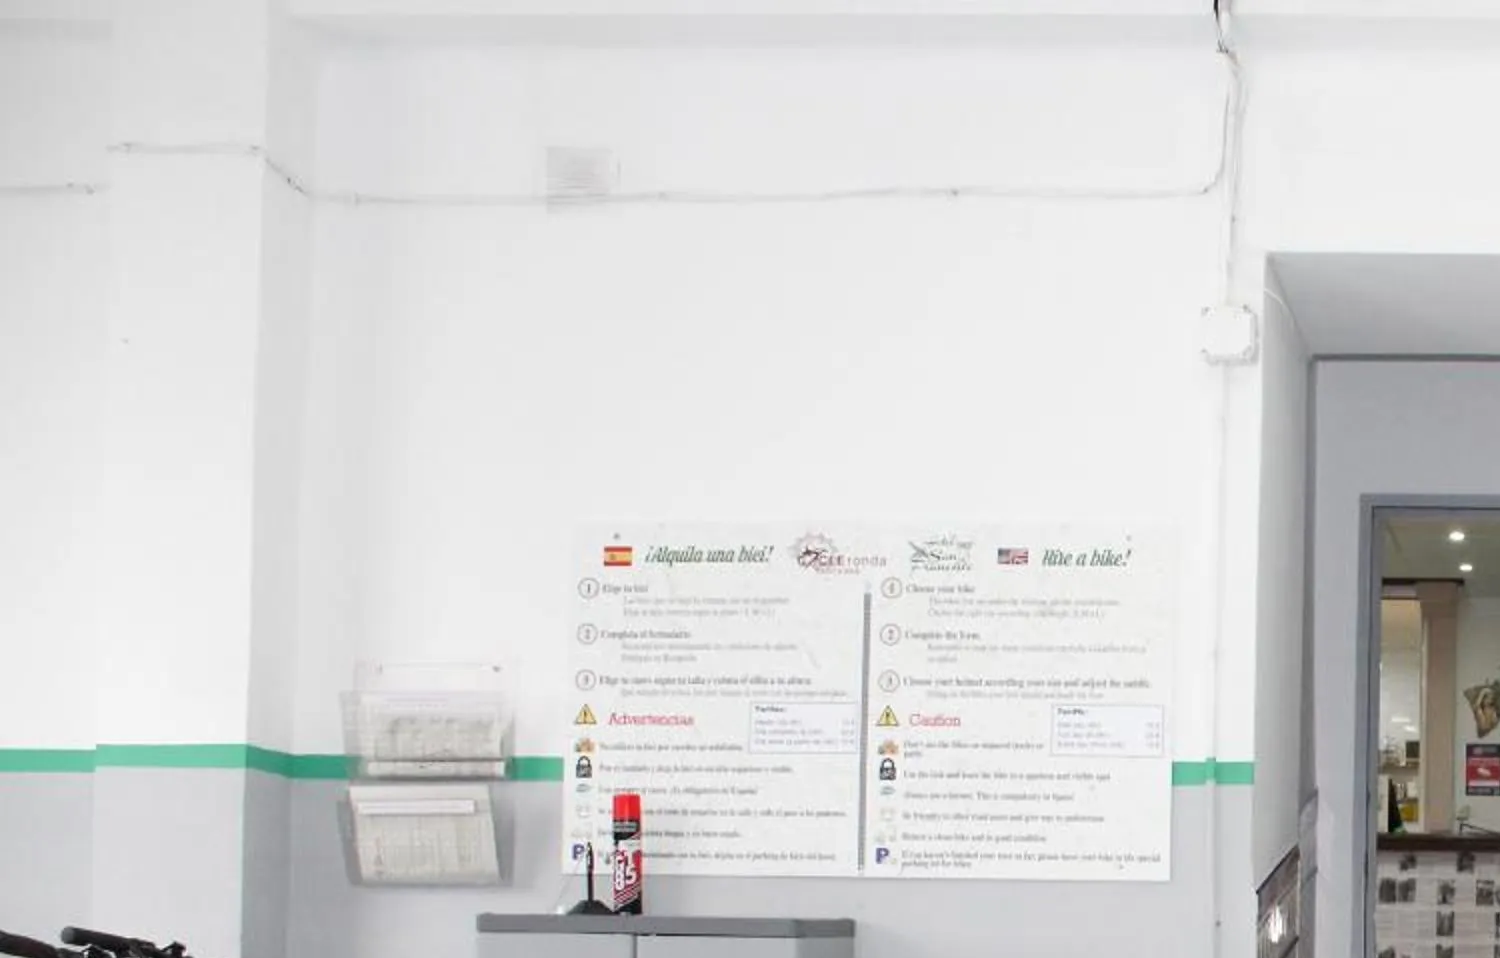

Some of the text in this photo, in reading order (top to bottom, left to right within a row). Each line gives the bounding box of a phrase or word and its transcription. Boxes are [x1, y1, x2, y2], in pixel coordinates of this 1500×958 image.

[706, 549, 735, 564] una
[737, 545, 775, 564] bici!
[847, 554, 888, 568] ronda
[1041, 548, 1132, 567] Hire a bike!
[607, 711, 695, 727] Advertencias
[908, 712, 961, 727] Caution
[875, 847, 891, 865] P
